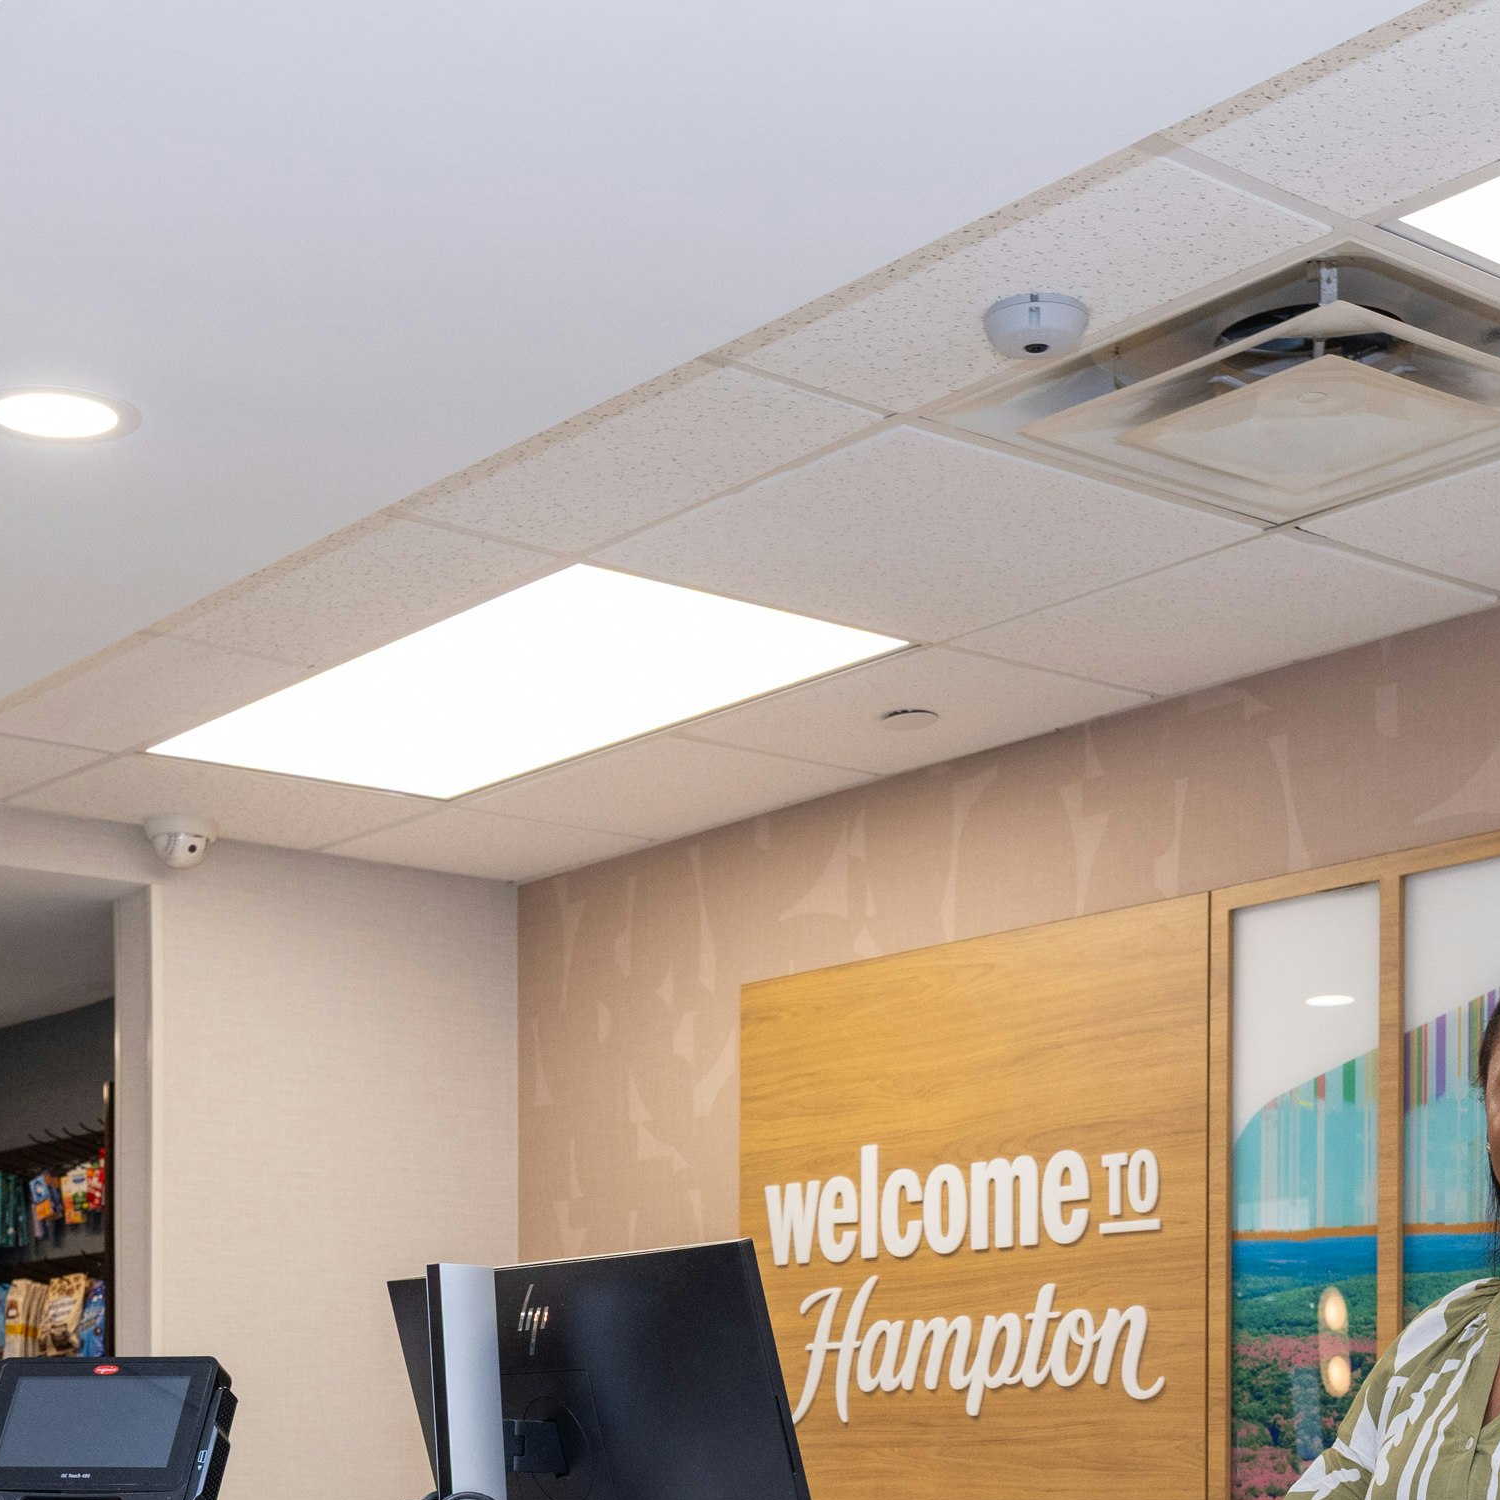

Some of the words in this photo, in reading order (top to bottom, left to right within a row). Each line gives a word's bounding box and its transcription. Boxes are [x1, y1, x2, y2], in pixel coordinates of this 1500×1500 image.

[764, 1143, 1091, 1267] welcome
[1101, 1148, 1160, 1217] TO
[793, 1275, 1166, 1424] Hampton
